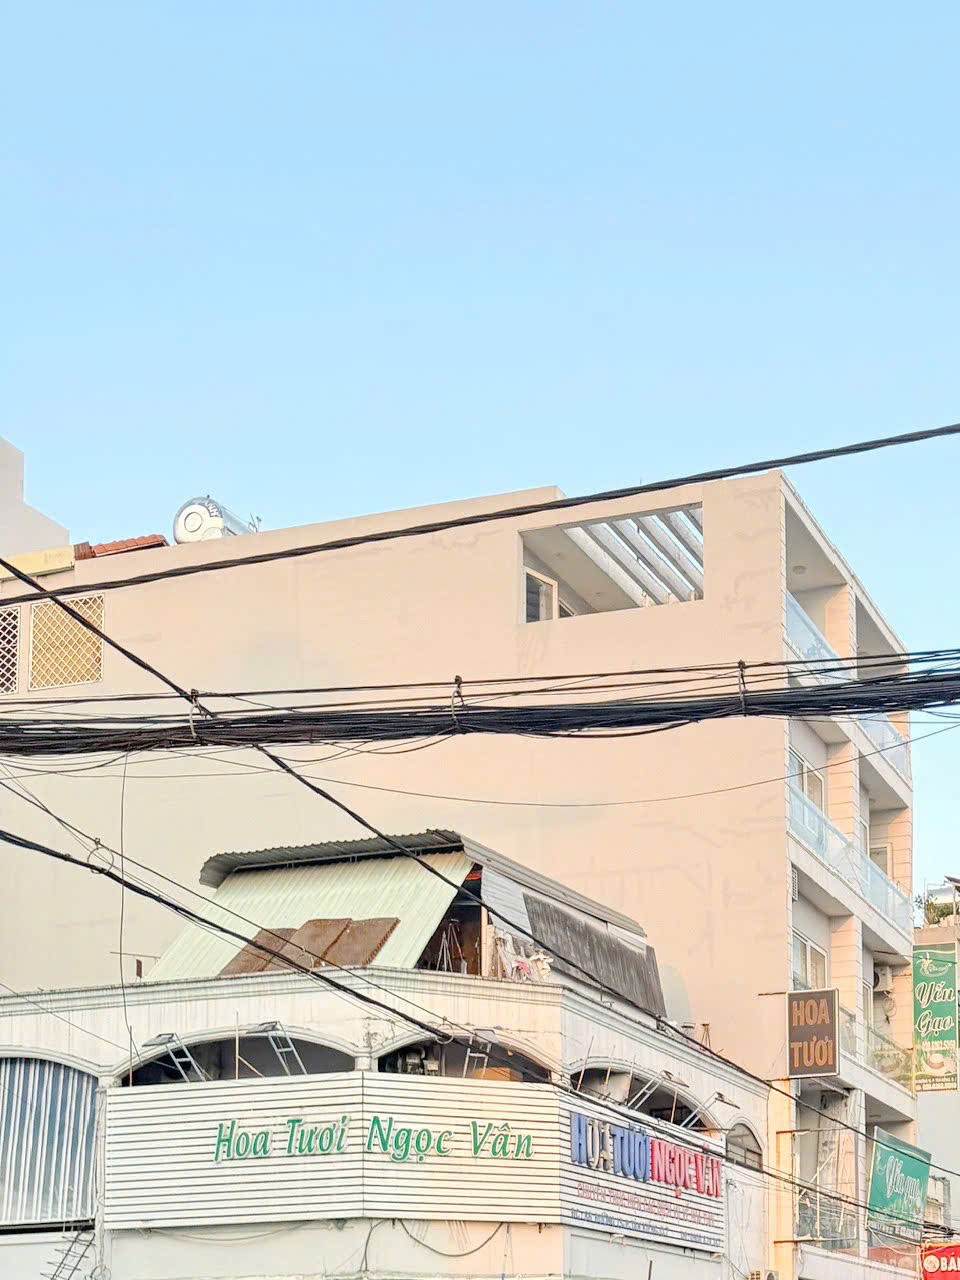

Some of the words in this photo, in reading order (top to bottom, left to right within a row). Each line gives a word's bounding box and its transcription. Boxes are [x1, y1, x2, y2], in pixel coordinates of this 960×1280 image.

[914, 981, 955, 1008] Yến
[792, 999, 830, 1026] HOA
[790, 1035, 833, 1068] TƯƠI
[214, 1118, 272, 1163] Hoa
[285, 1114, 349, 1155] Tươi
[366, 1114, 454, 1164] Ngọc
[470, 1121, 535, 1160] Vân
[570, 1112, 611, 1171] HOA
